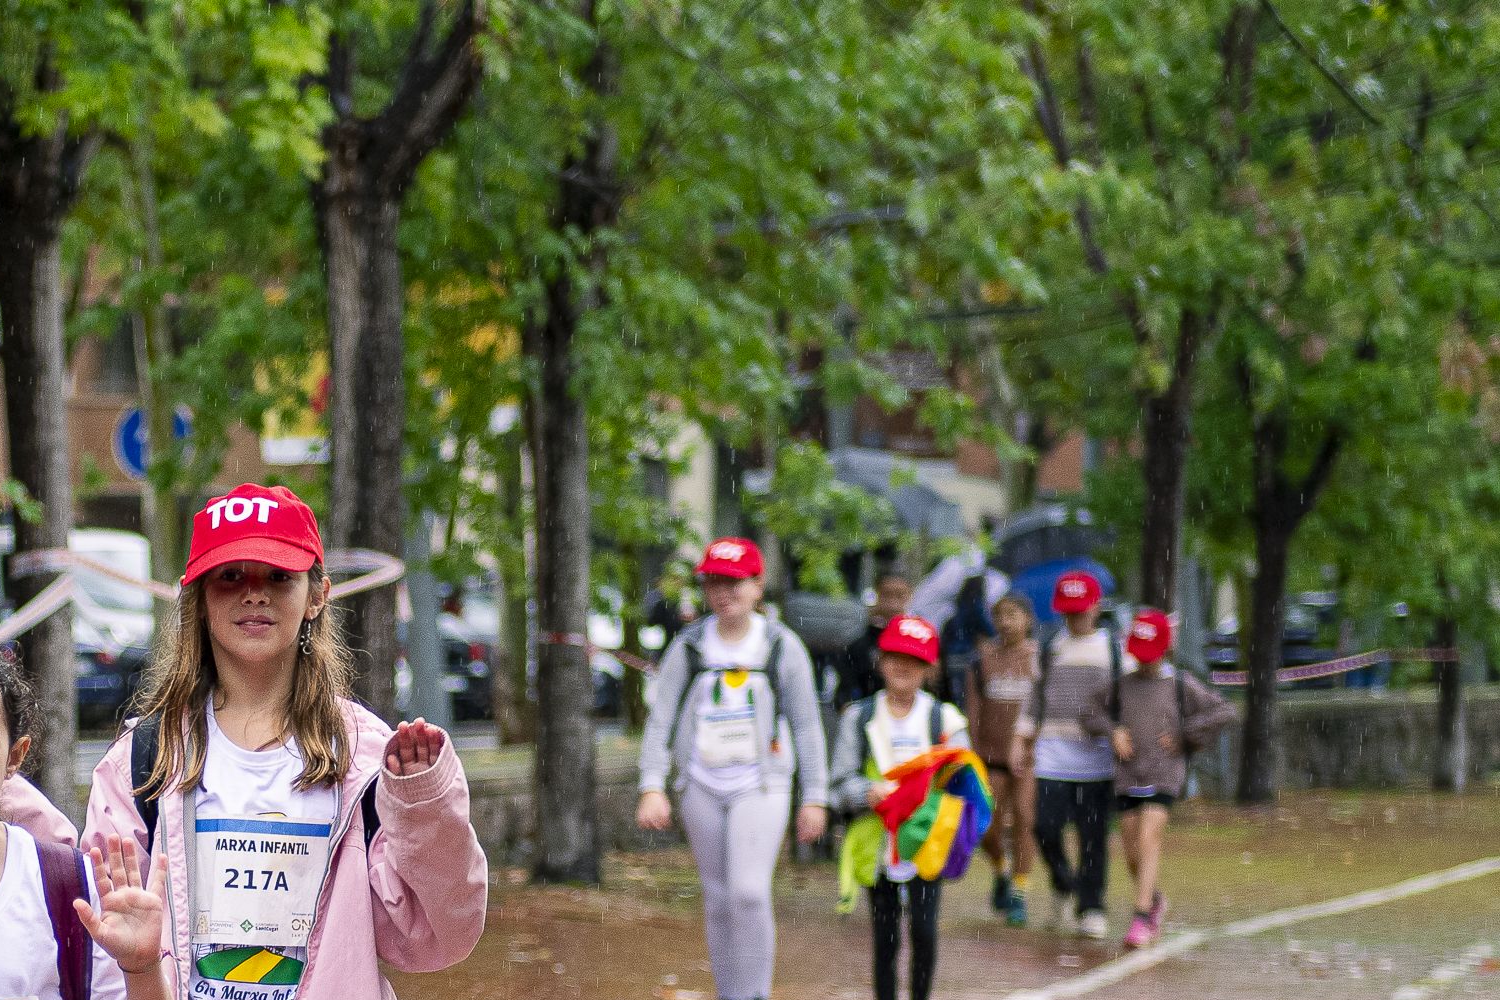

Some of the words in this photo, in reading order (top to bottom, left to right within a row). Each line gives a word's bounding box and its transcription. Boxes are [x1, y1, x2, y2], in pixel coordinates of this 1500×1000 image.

[206, 497, 279, 530] TOT
[260, 841, 309, 855] INFANTIL
[224, 868, 289, 891] 217A
[195, 980, 217, 998] 67a
